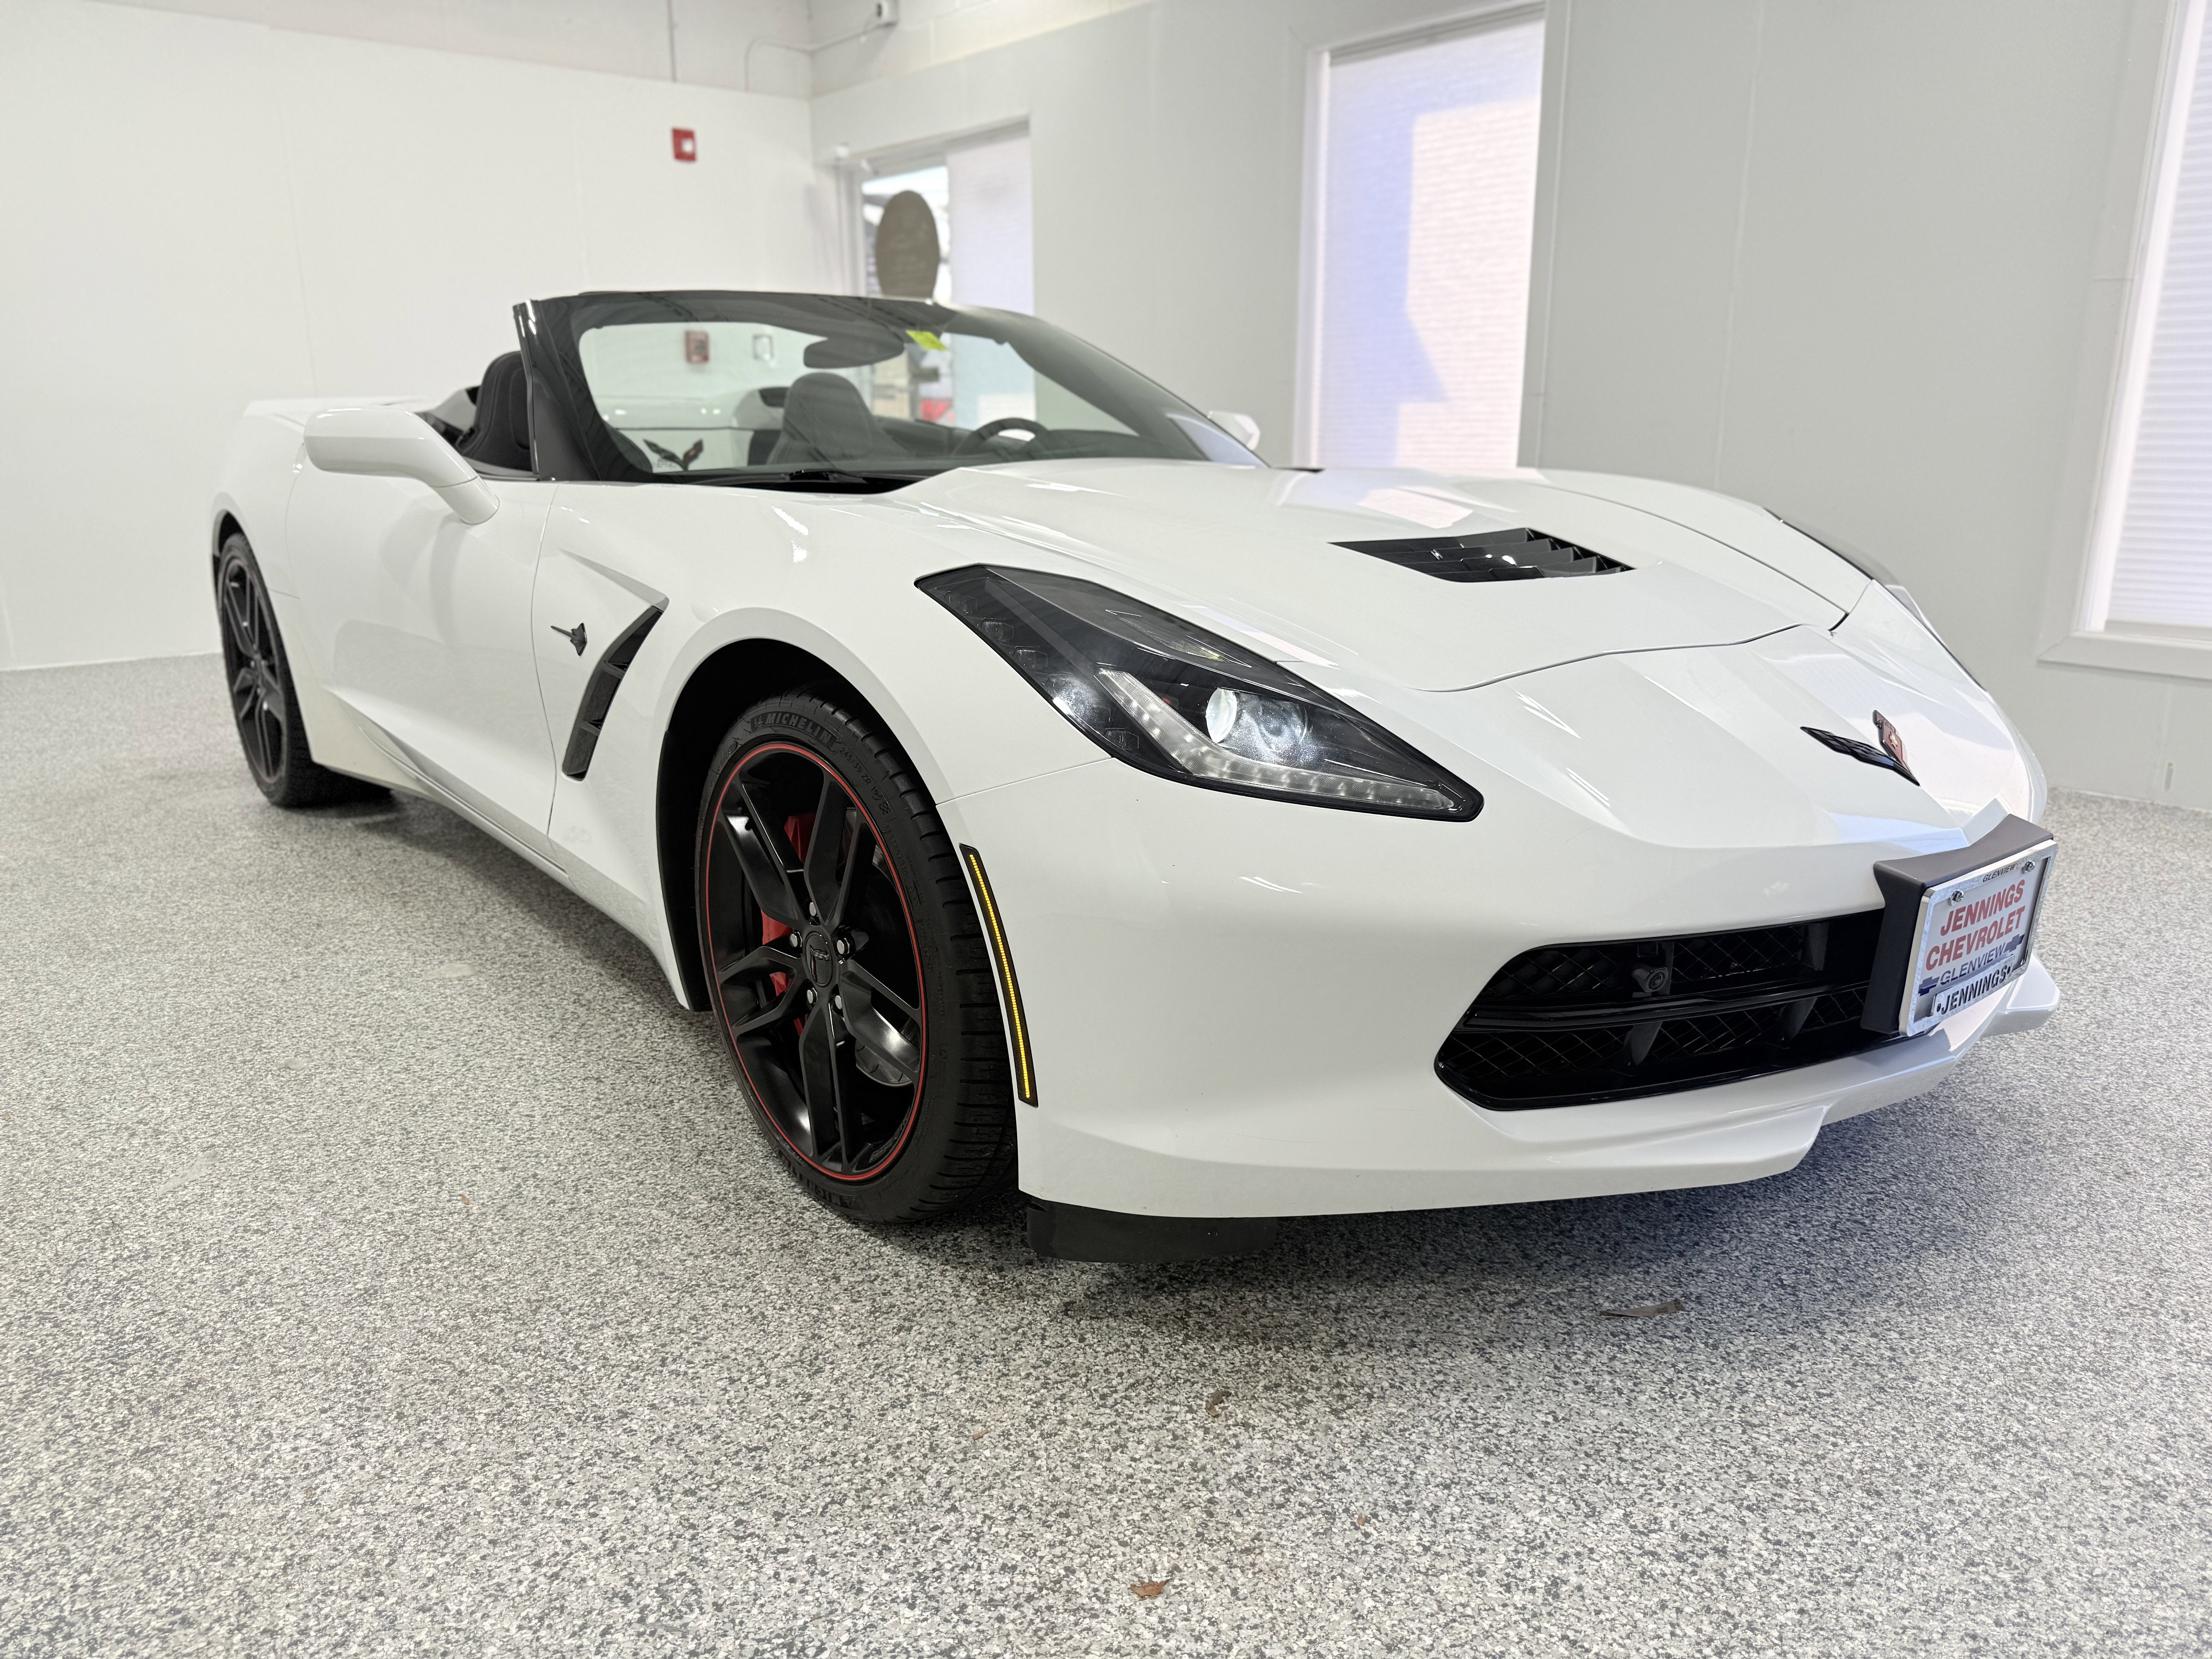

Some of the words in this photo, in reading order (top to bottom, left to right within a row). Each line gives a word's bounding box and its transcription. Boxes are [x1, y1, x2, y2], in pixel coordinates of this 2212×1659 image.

[765, 712, 832, 745] MICHELIN
[840, 747, 863, 773] 245/35
[861, 773, 871, 785] ZR
[871, 786, 879, 795] 19
[1983, 862, 2017, 883] GLENVIEW
[1940, 879, 2025, 936] JENNINGS
[1925, 905, 2025, 971] CHEVROLET
[1940, 942, 2006, 985] GLENVIEW
